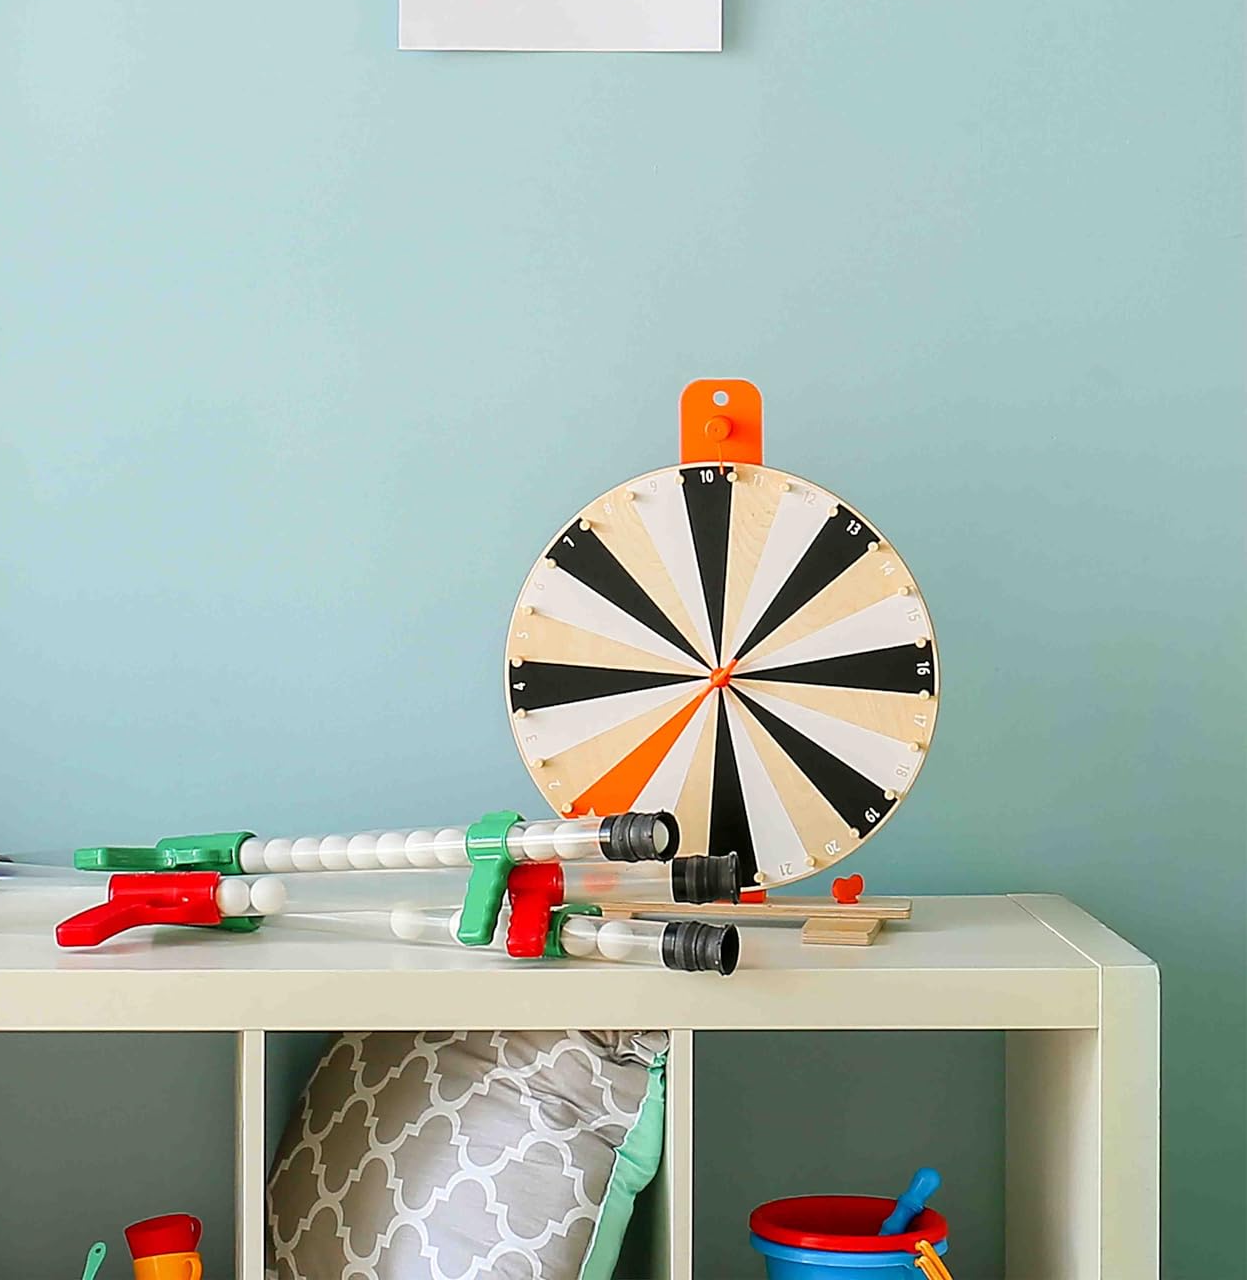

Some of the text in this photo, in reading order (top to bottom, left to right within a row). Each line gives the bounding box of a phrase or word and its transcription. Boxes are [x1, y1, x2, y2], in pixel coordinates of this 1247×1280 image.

[699, 469, 714, 484] 10
[846, 519, 862, 536] 13
[562, 535, 575, 548] 7
[916, 660, 931, 676] 16
[512, 681, 527, 692] 4
[913, 712, 929, 728] 17
[895, 762, 910, 778] 18
[864, 806, 881, 824] 19
[824, 839, 842, 856] 20
[778, 862, 794, 877] 21
